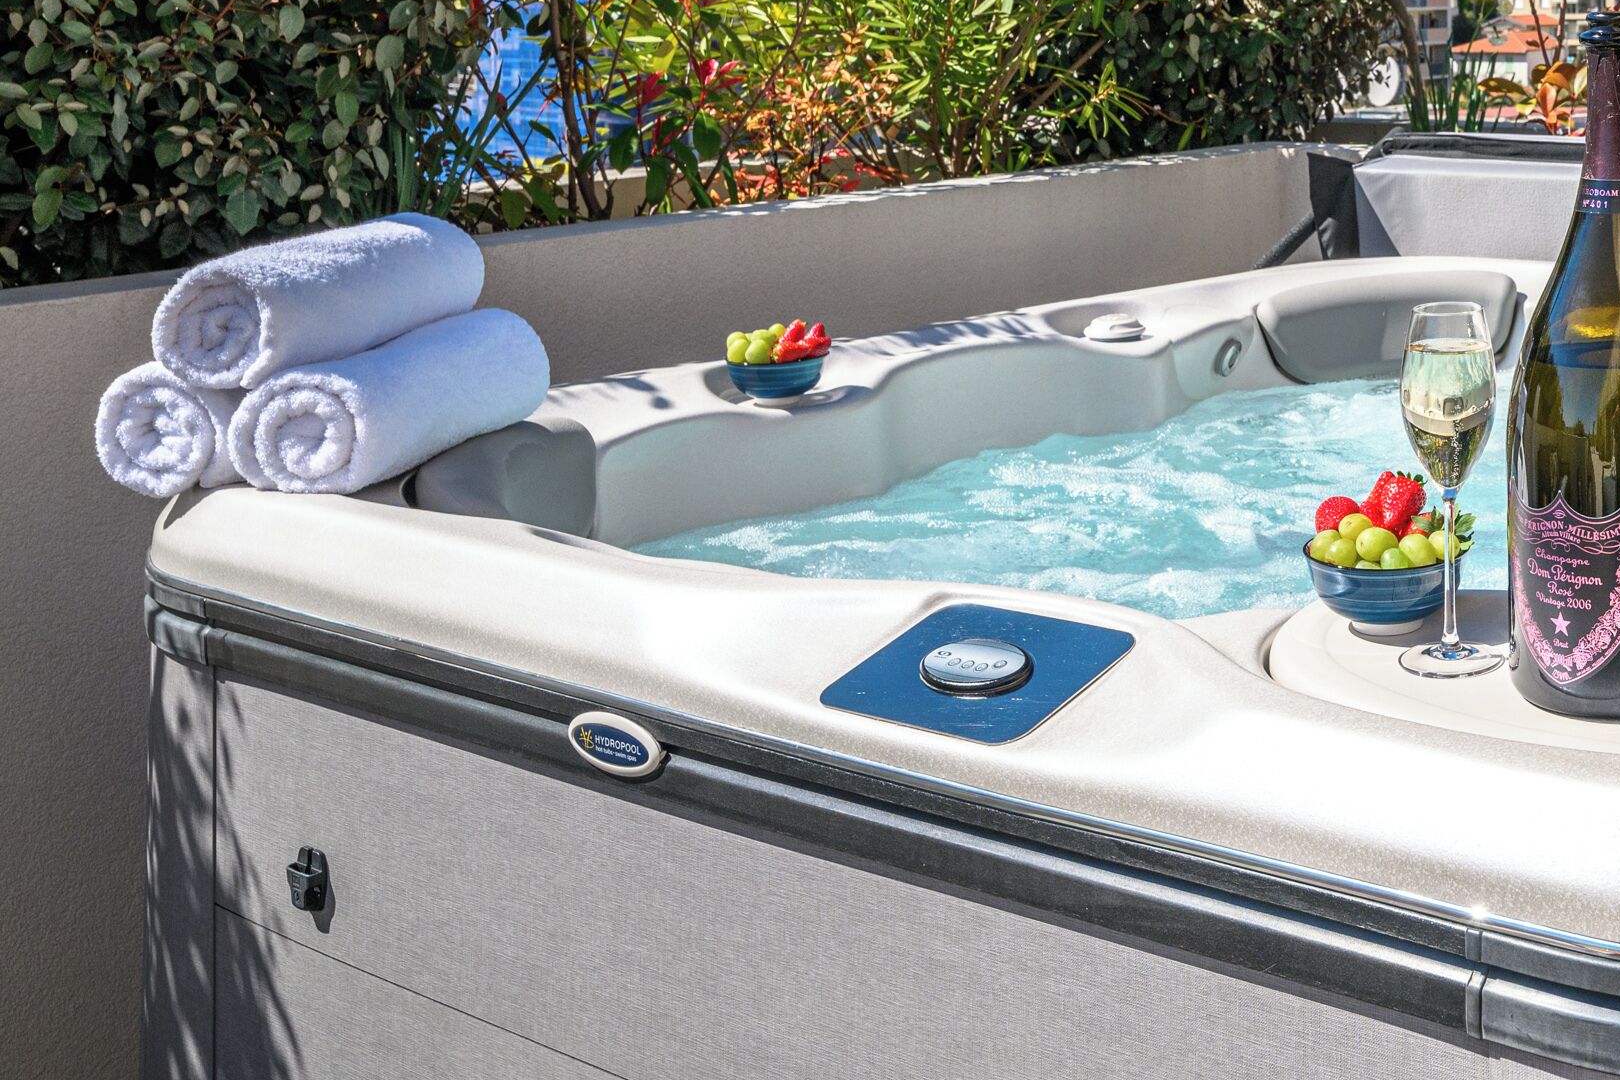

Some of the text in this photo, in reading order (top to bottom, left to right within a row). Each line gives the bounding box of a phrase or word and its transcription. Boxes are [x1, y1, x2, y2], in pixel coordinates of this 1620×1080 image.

[1535, 547, 1590, 568] Champagne
[1527, 558, 1603, 589] Dom Pérignon
[1547, 581, 1574, 597] Rosé
[1536, 591, 1592, 610] Vintage 2006
[1553, 638, 1569, 648] Brut
[595, 735, 641, 755] HYDROPOOL
